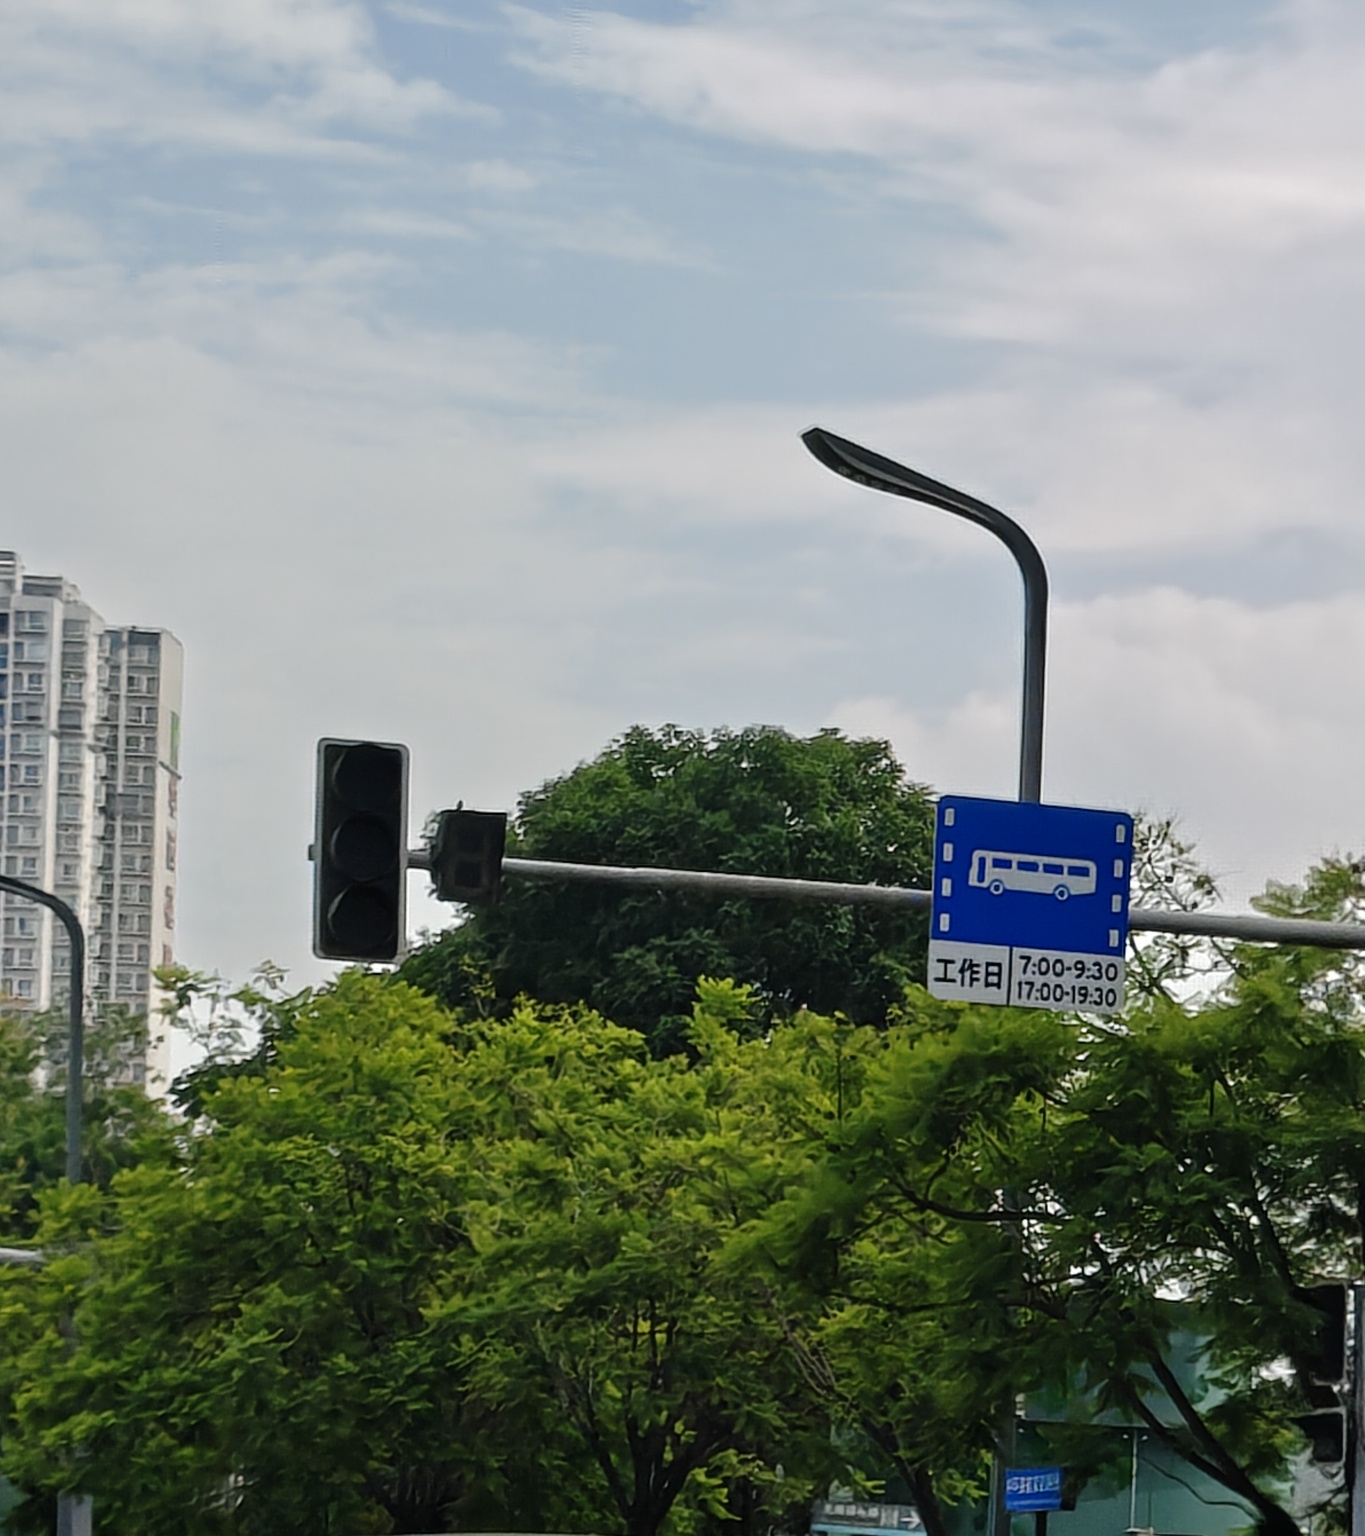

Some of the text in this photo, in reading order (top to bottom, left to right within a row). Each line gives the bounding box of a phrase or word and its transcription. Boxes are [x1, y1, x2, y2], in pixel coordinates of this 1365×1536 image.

[934, 957, 1003, 991] 工作日
[1018, 955, 1119, 983] 7:00-9:30
[1016, 982, 1118, 1008] 17:00-19:30
